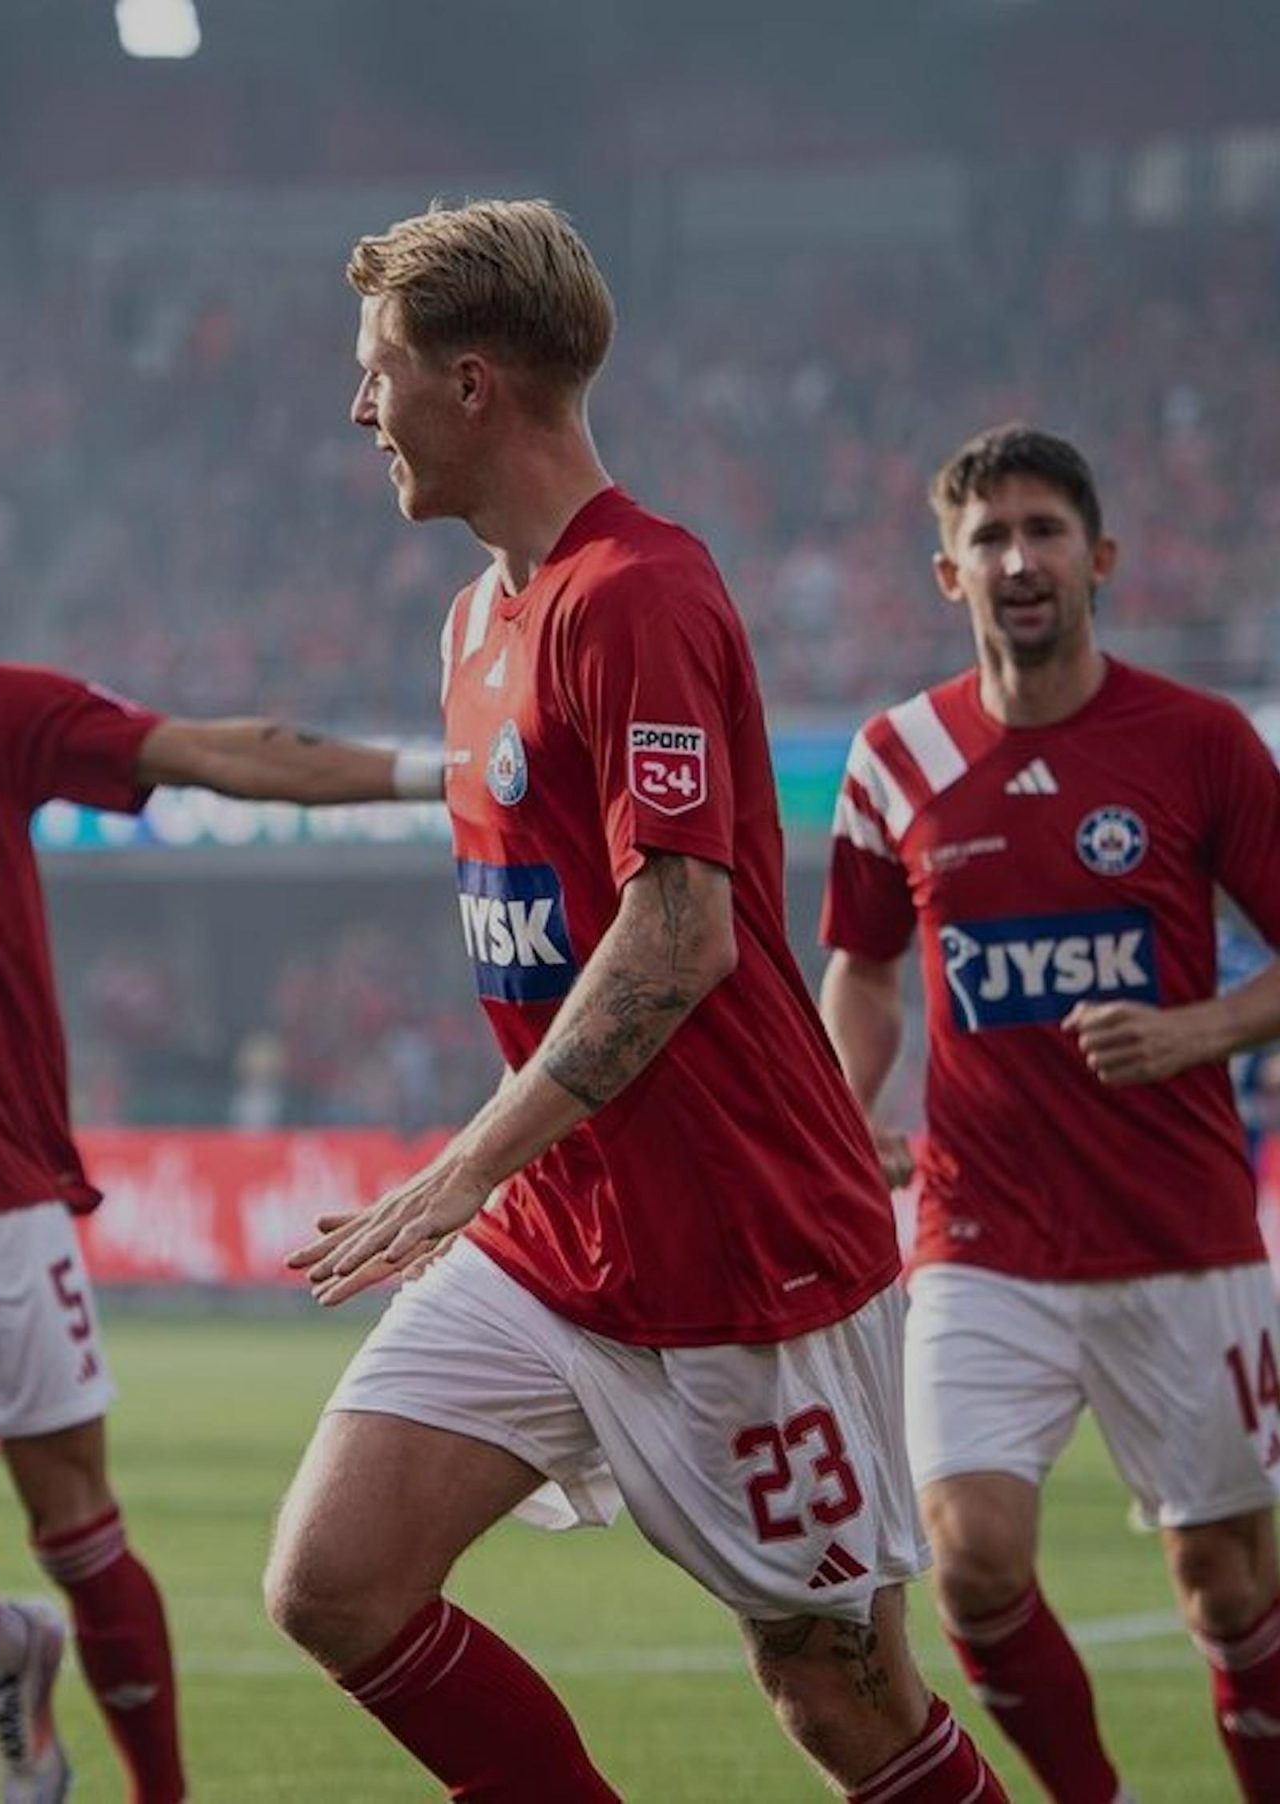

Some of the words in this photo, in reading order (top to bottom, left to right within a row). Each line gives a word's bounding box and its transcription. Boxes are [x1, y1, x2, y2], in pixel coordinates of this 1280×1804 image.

[632, 730, 701, 750] SPORT
[641, 762, 696, 796] 24
[980, 929, 1148, 1000] JYSK
[48, 1255, 90, 1343] 5
[1226, 1328, 1280, 1434] 14
[732, 1404, 863, 1544] 23
